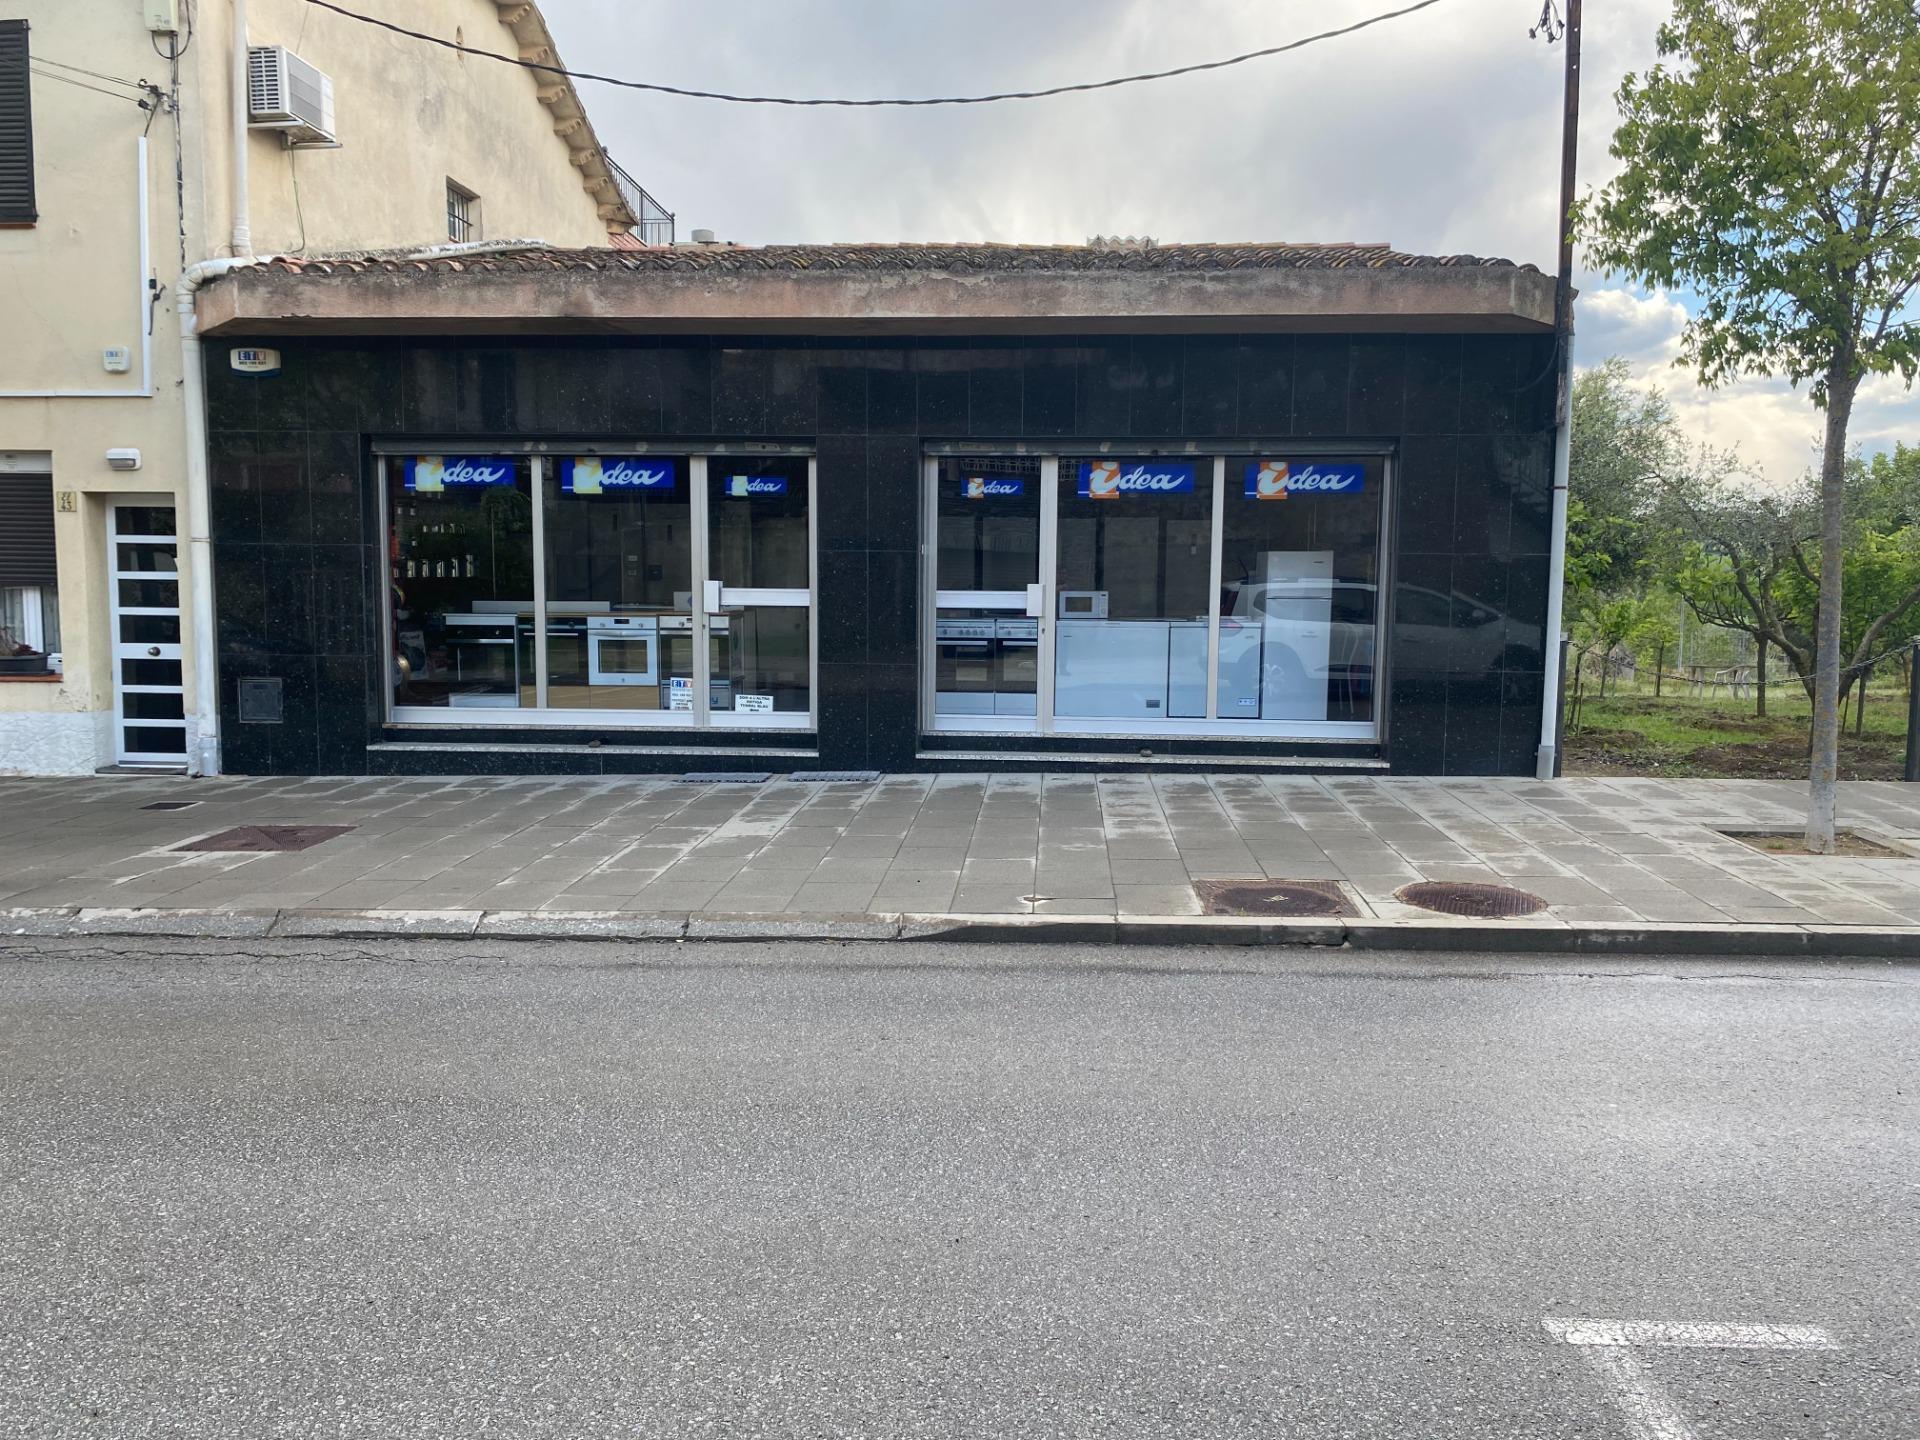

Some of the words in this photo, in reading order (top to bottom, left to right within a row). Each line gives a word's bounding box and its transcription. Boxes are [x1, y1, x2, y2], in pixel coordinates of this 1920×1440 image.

[732, 476, 782, 494] dea
[1090, 461, 1186, 493] idea
[1257, 461, 1355, 494] idea
